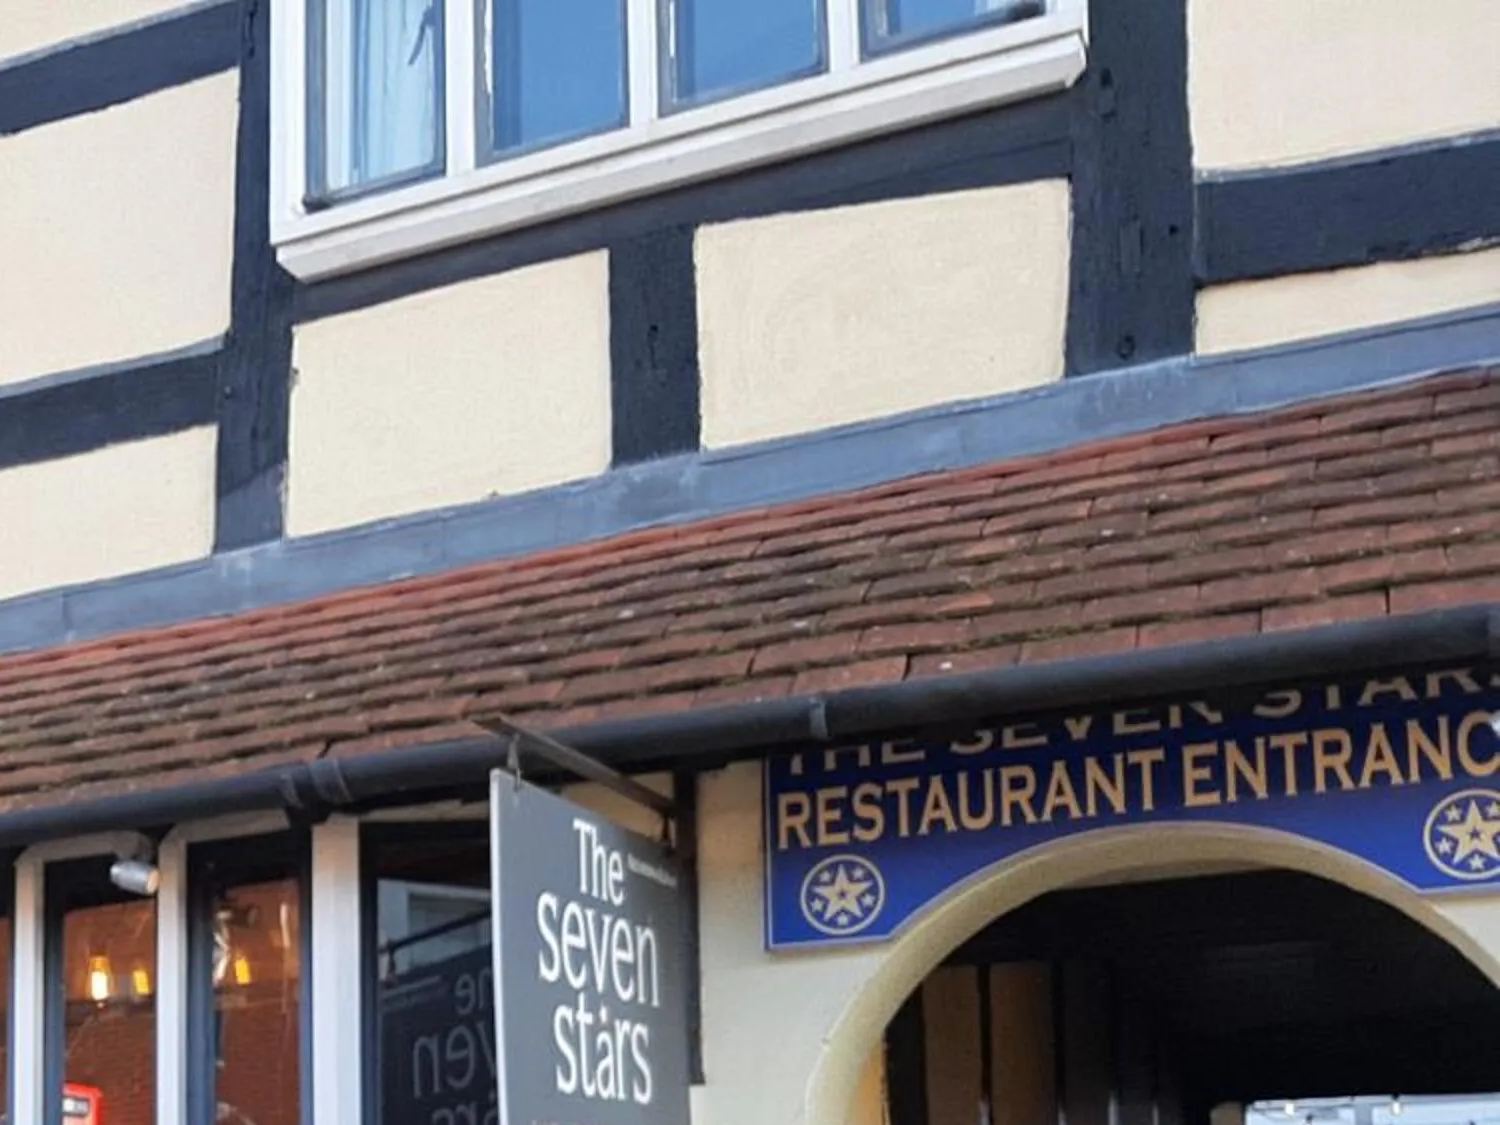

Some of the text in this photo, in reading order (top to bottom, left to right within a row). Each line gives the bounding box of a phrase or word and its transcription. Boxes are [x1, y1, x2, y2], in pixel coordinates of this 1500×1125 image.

[776, 709, 1500, 850] RESTAURANT ENTRANC
[573, 818, 625, 907] The
